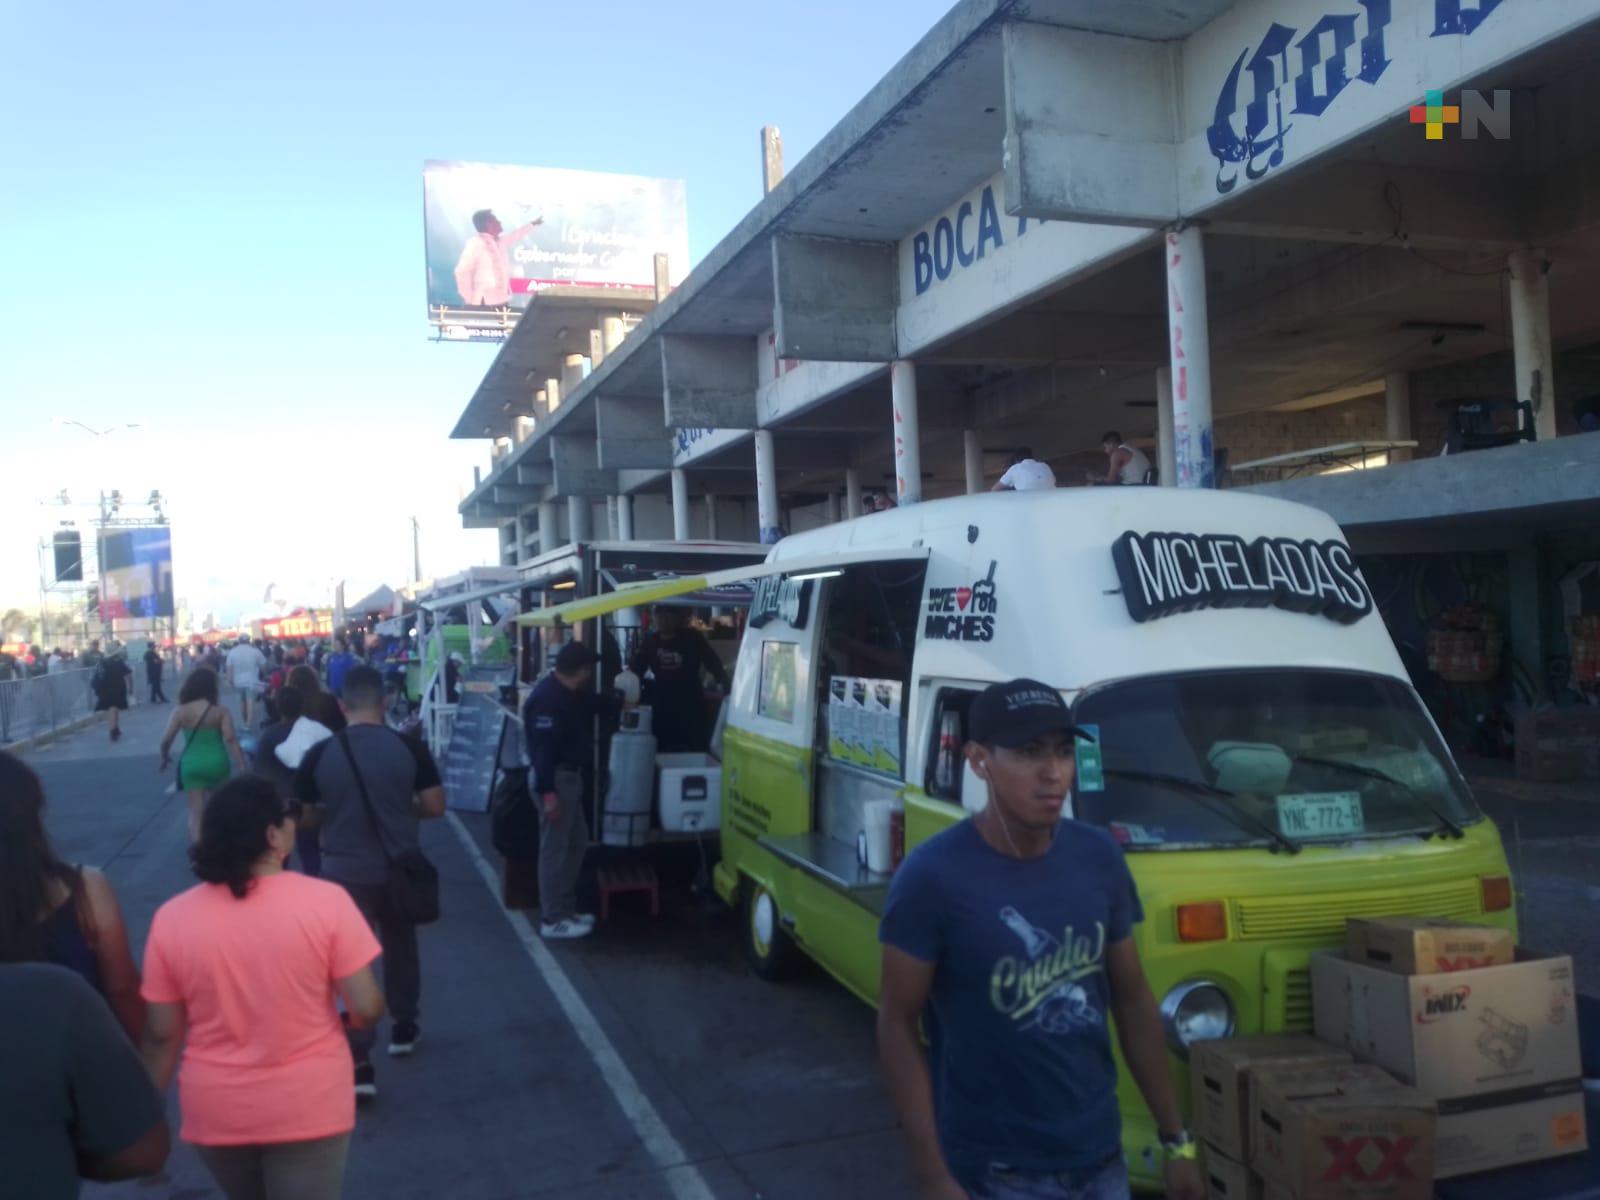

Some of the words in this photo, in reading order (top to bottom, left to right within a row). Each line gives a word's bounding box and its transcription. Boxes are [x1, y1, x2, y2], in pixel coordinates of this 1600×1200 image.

[912, 184, 1004, 296] BOCA
[1130, 536, 1367, 609] MICHELADAS
[928, 587, 956, 612] WE
[924, 615, 995, 642] MICHES
